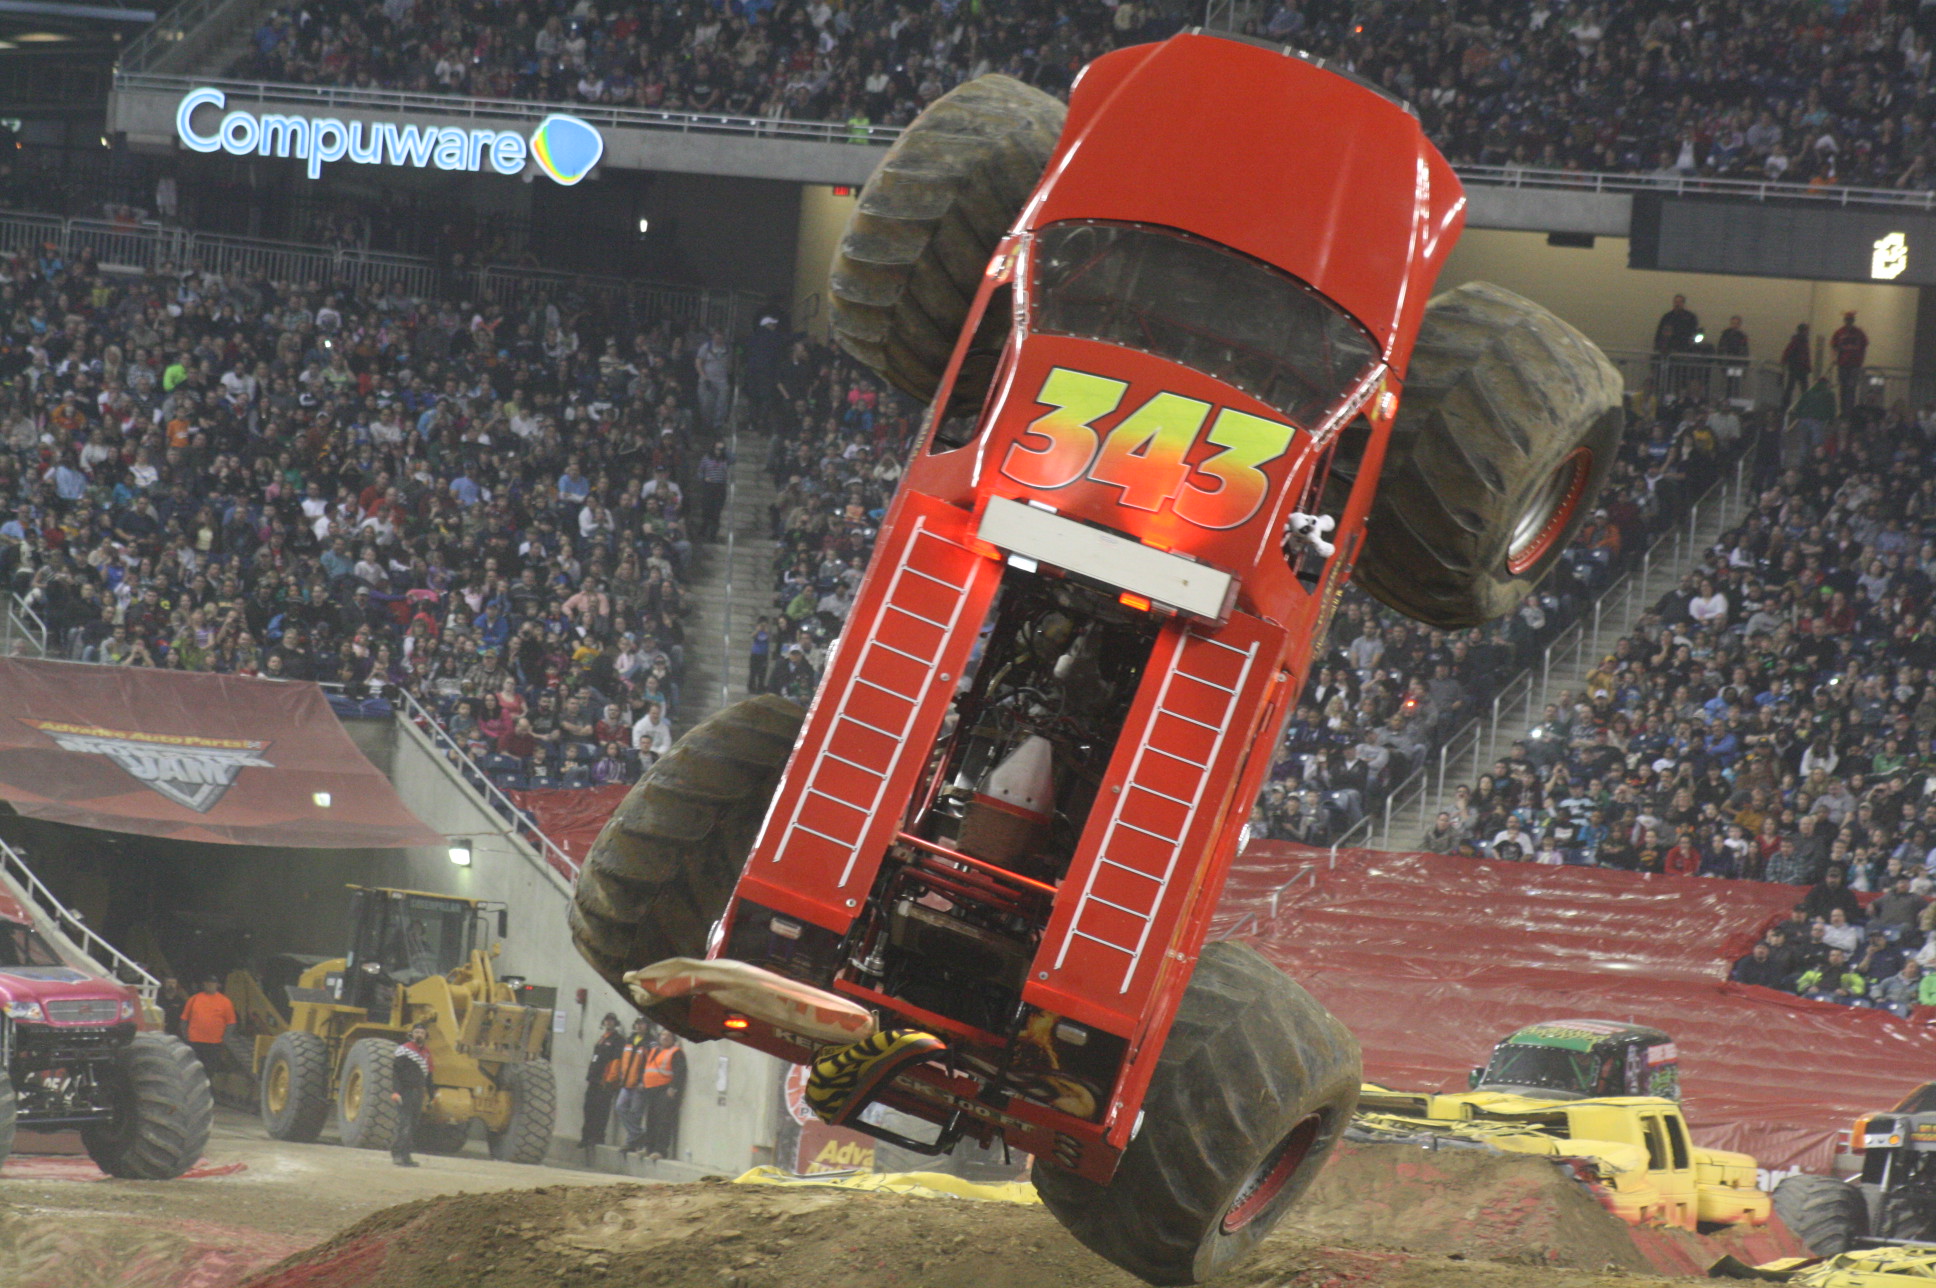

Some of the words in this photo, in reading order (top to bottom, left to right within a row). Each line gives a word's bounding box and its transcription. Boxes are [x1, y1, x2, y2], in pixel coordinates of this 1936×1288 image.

[176, 87, 527, 179] Compuware
[1000, 365, 1297, 530] 343
[38, 720, 127, 740] Advance
[129, 731, 182, 746] Auto
[184, 736, 248, 750] Parts
[129, 752, 230, 786] JAM
[944, 1094, 991, 1116] 100
